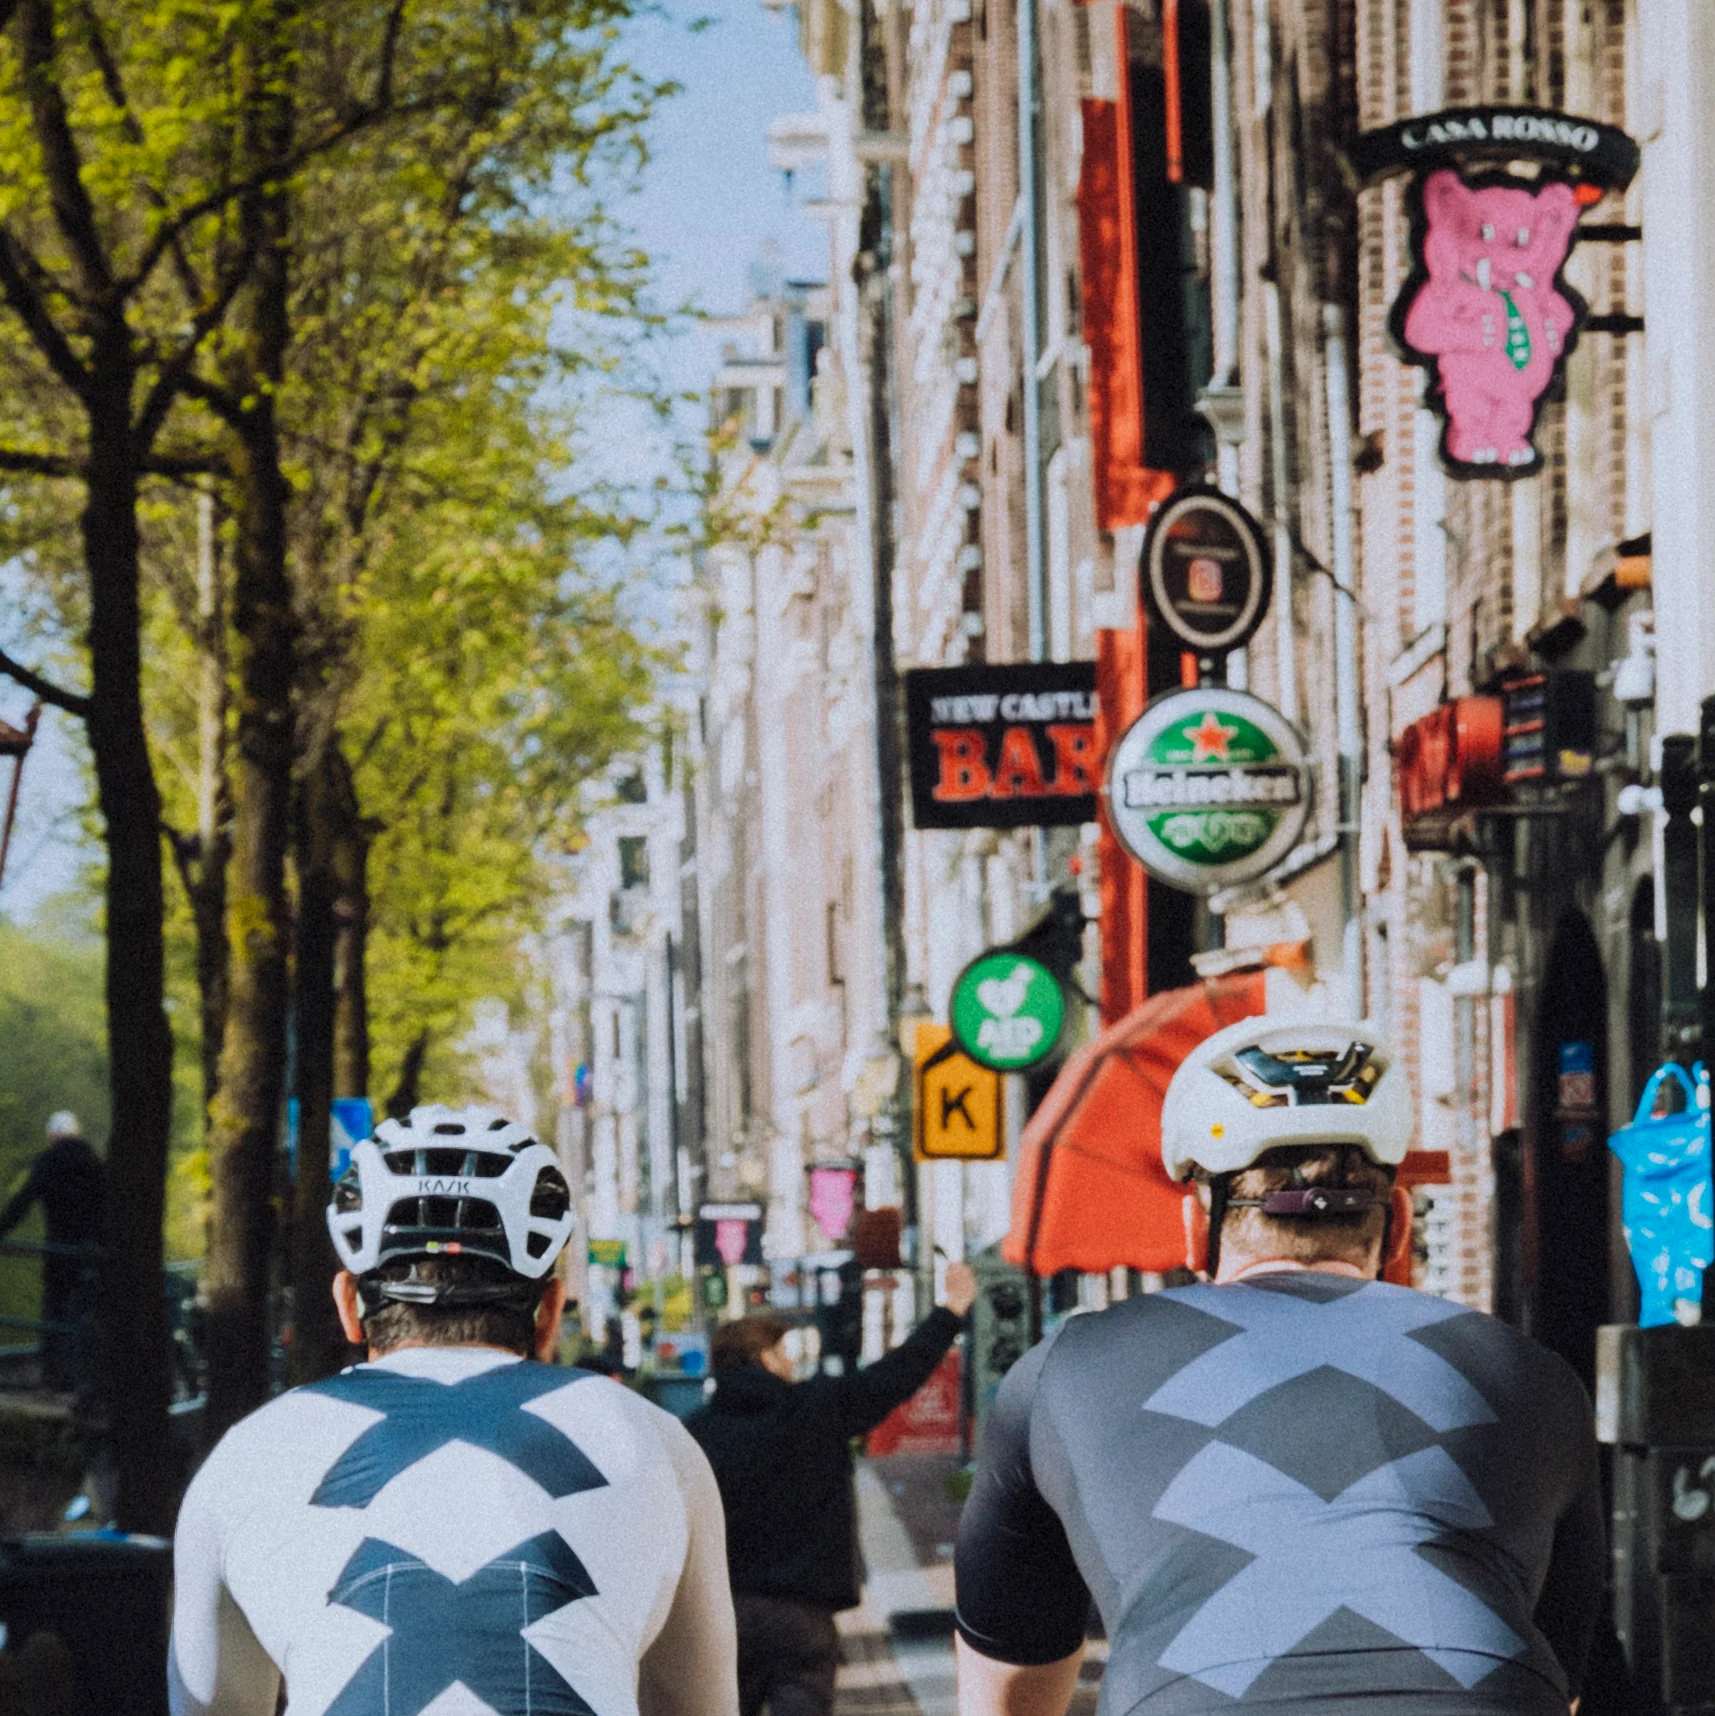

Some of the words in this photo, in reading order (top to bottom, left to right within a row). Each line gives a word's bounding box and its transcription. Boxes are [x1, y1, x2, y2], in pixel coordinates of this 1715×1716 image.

[1401, 118, 1488, 150] CASA
[1491, 114, 1600, 152] ROSSO
[1125, 768, 1297, 806] Heineken
[940, 1085, 976, 1131] K
